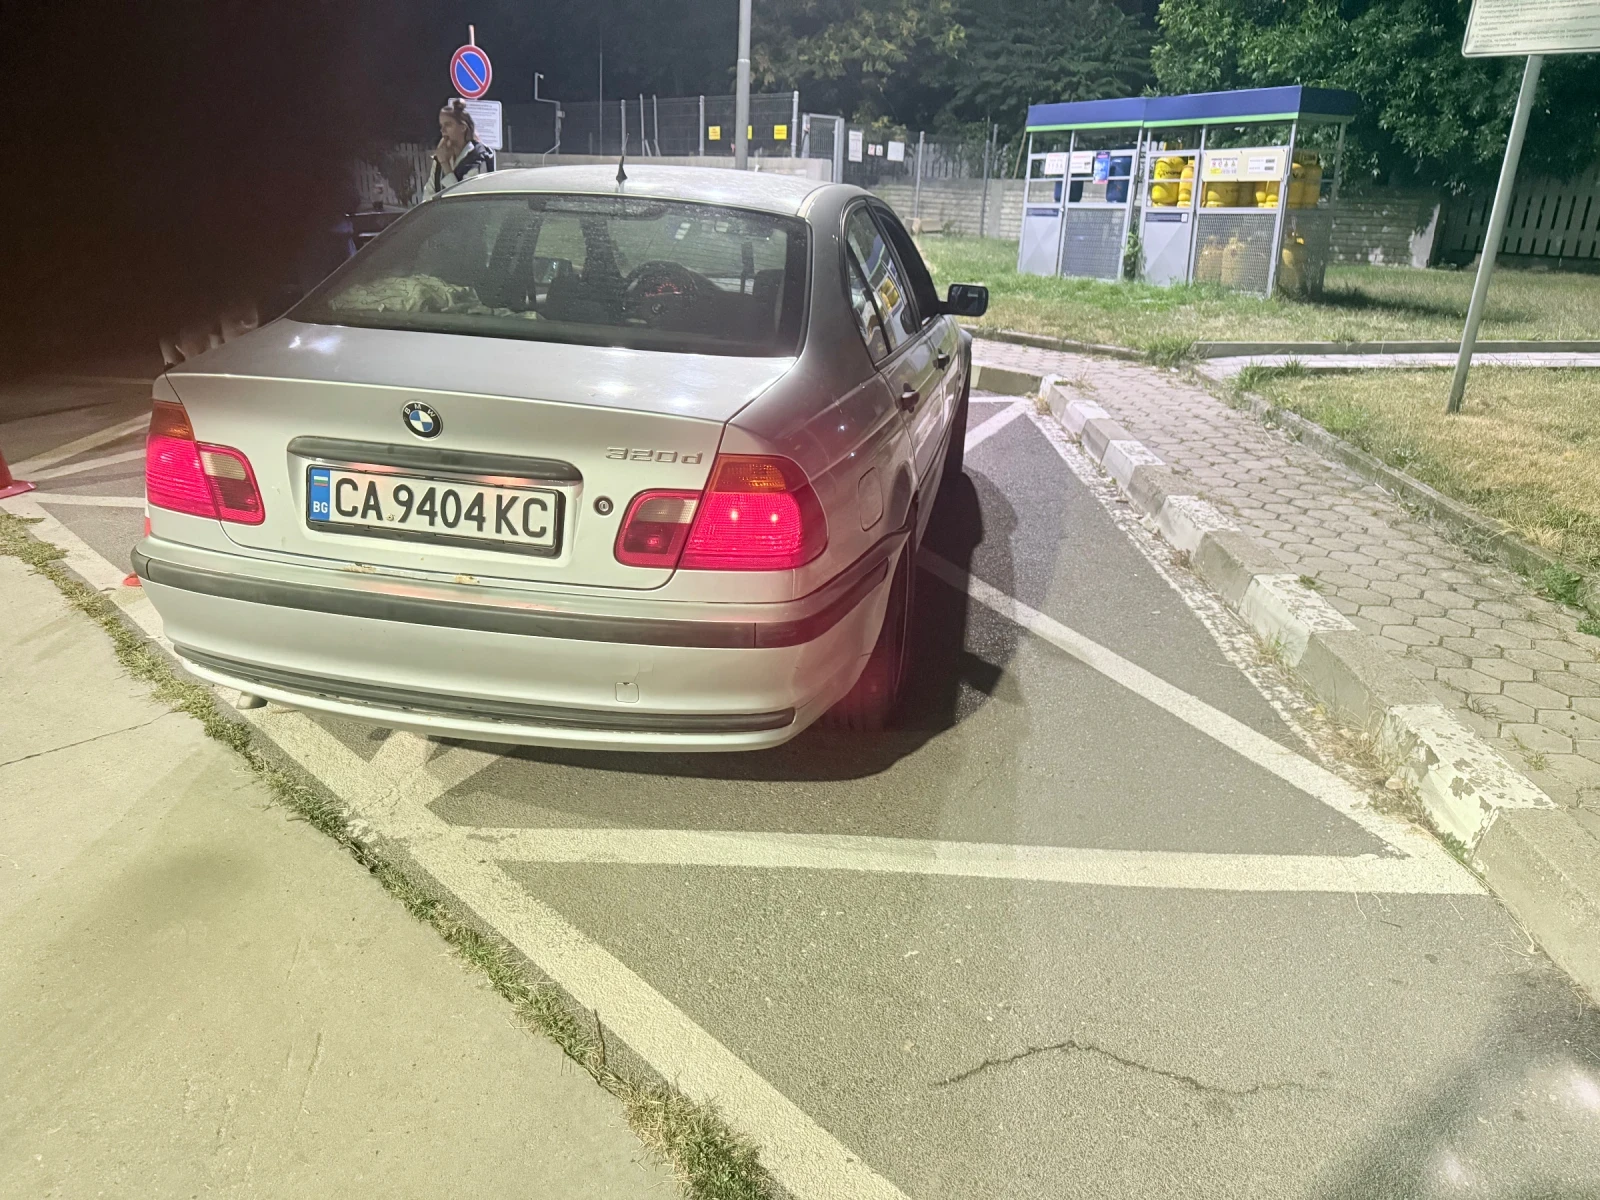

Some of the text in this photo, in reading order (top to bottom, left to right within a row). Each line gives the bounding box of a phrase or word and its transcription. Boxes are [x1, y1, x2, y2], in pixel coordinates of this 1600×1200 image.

[605, 446, 703, 465] 320d
[313, 500, 328, 514] BG
[335, 478, 548, 538] CA 9404 KC
